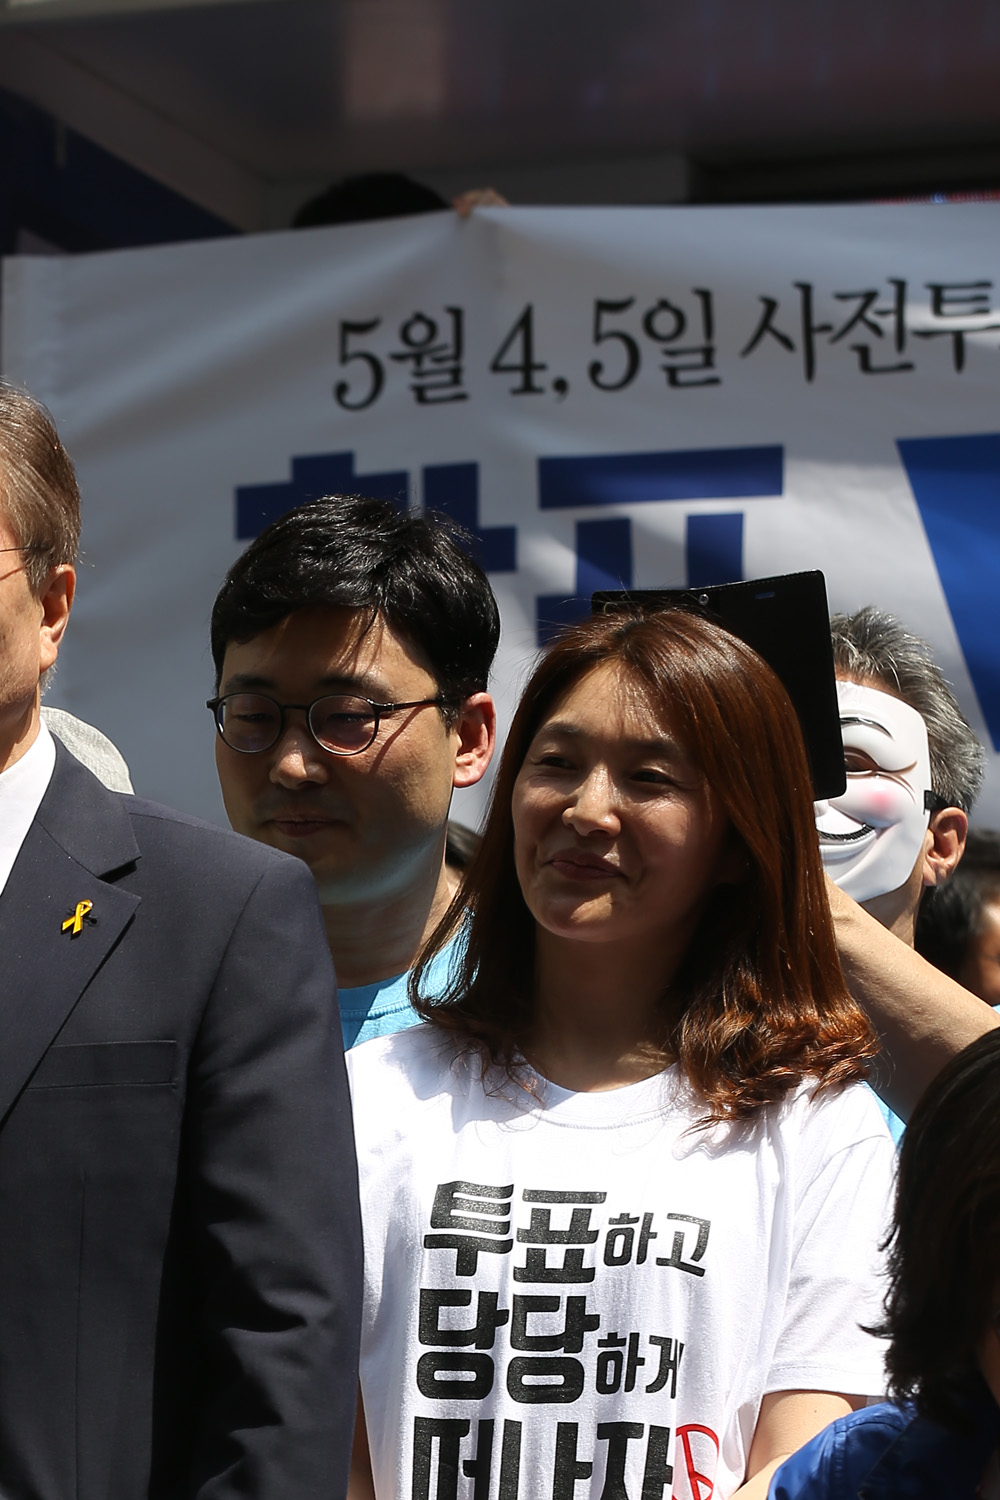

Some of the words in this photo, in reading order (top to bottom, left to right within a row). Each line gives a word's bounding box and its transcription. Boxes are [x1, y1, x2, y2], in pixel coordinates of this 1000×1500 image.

[333, 306, 470, 412] 5월
[739, 277, 1000, 384] 사전투
[422, 1180, 712, 1284] 투표하고
[416, 1288, 685, 1404] 당당하게
